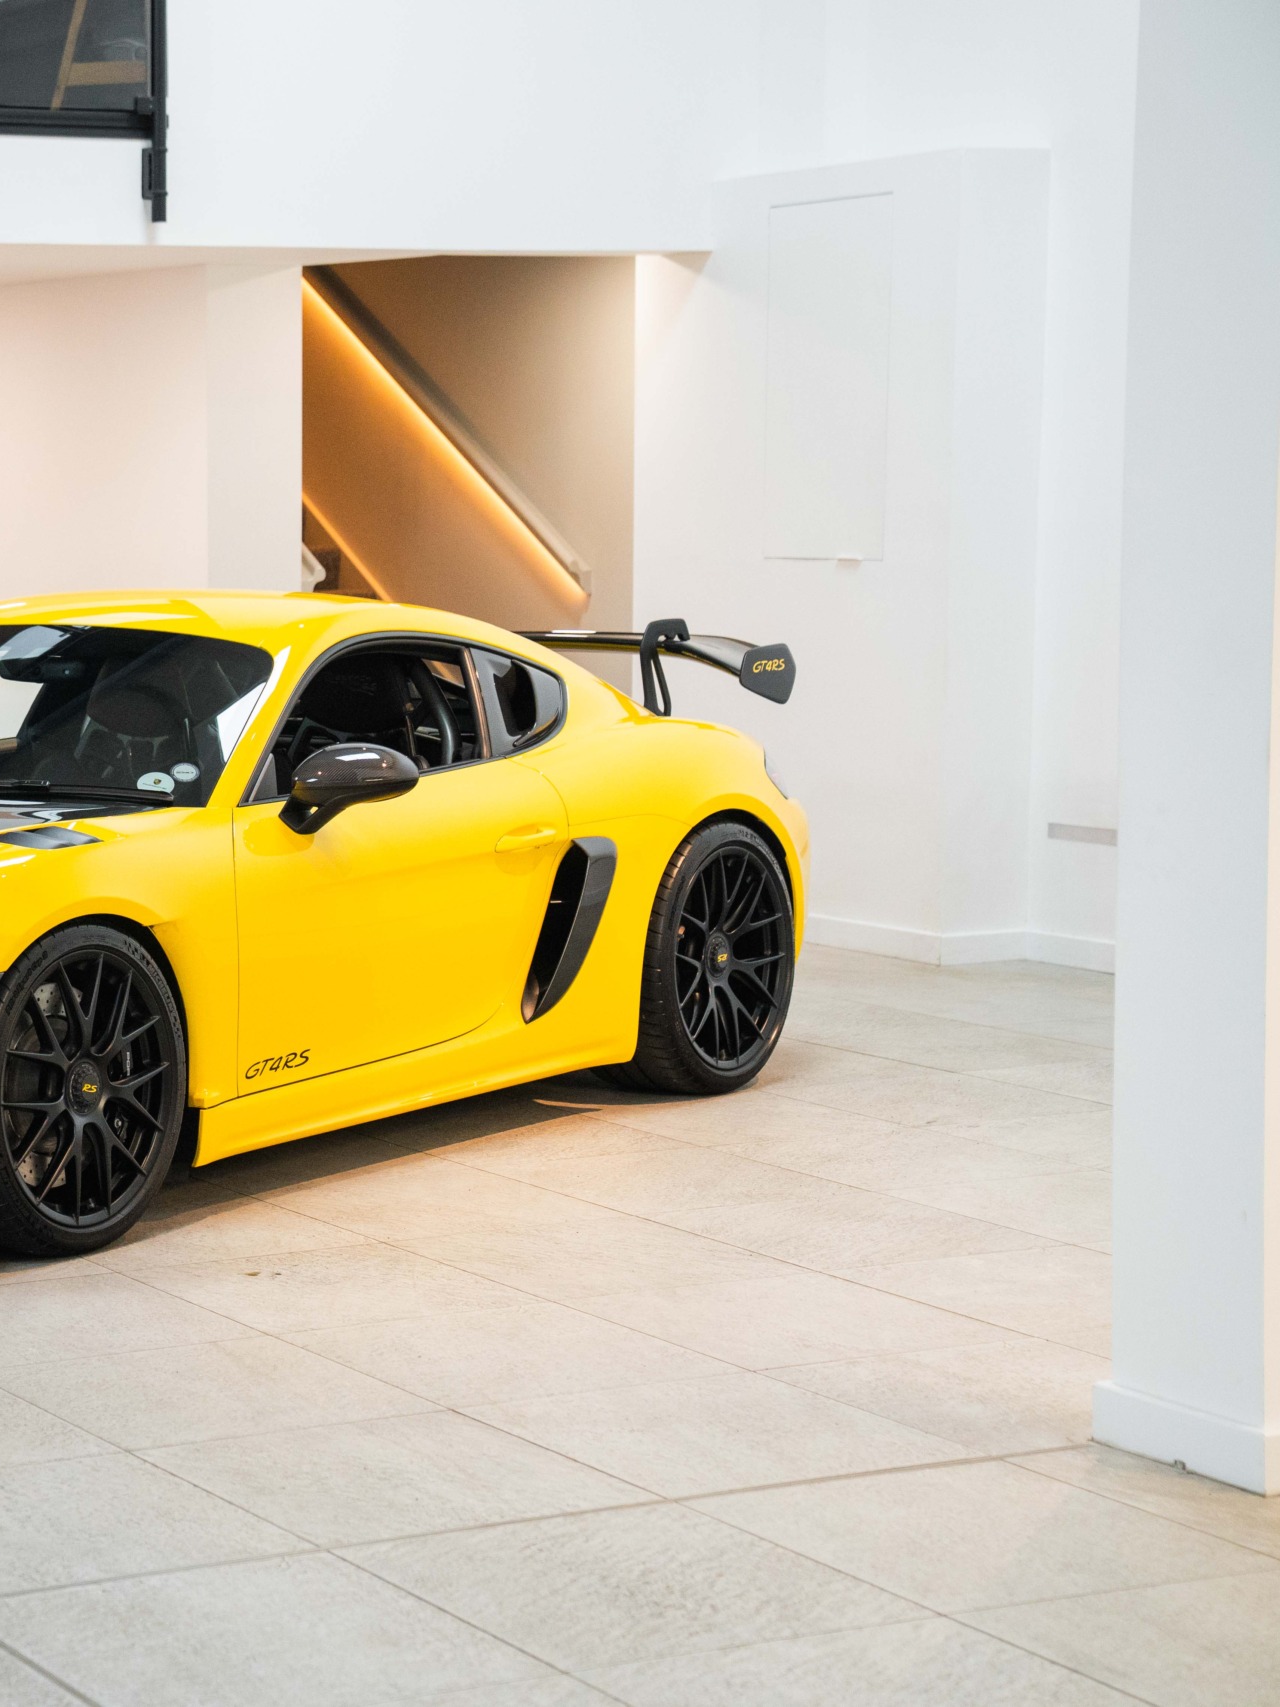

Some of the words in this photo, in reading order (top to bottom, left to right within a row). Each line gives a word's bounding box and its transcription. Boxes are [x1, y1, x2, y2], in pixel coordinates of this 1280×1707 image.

[752, 658, 786, 674] GT4RS
[245, 1048, 311, 1080] GT4RS
[81, 1083, 98, 1093] RS
